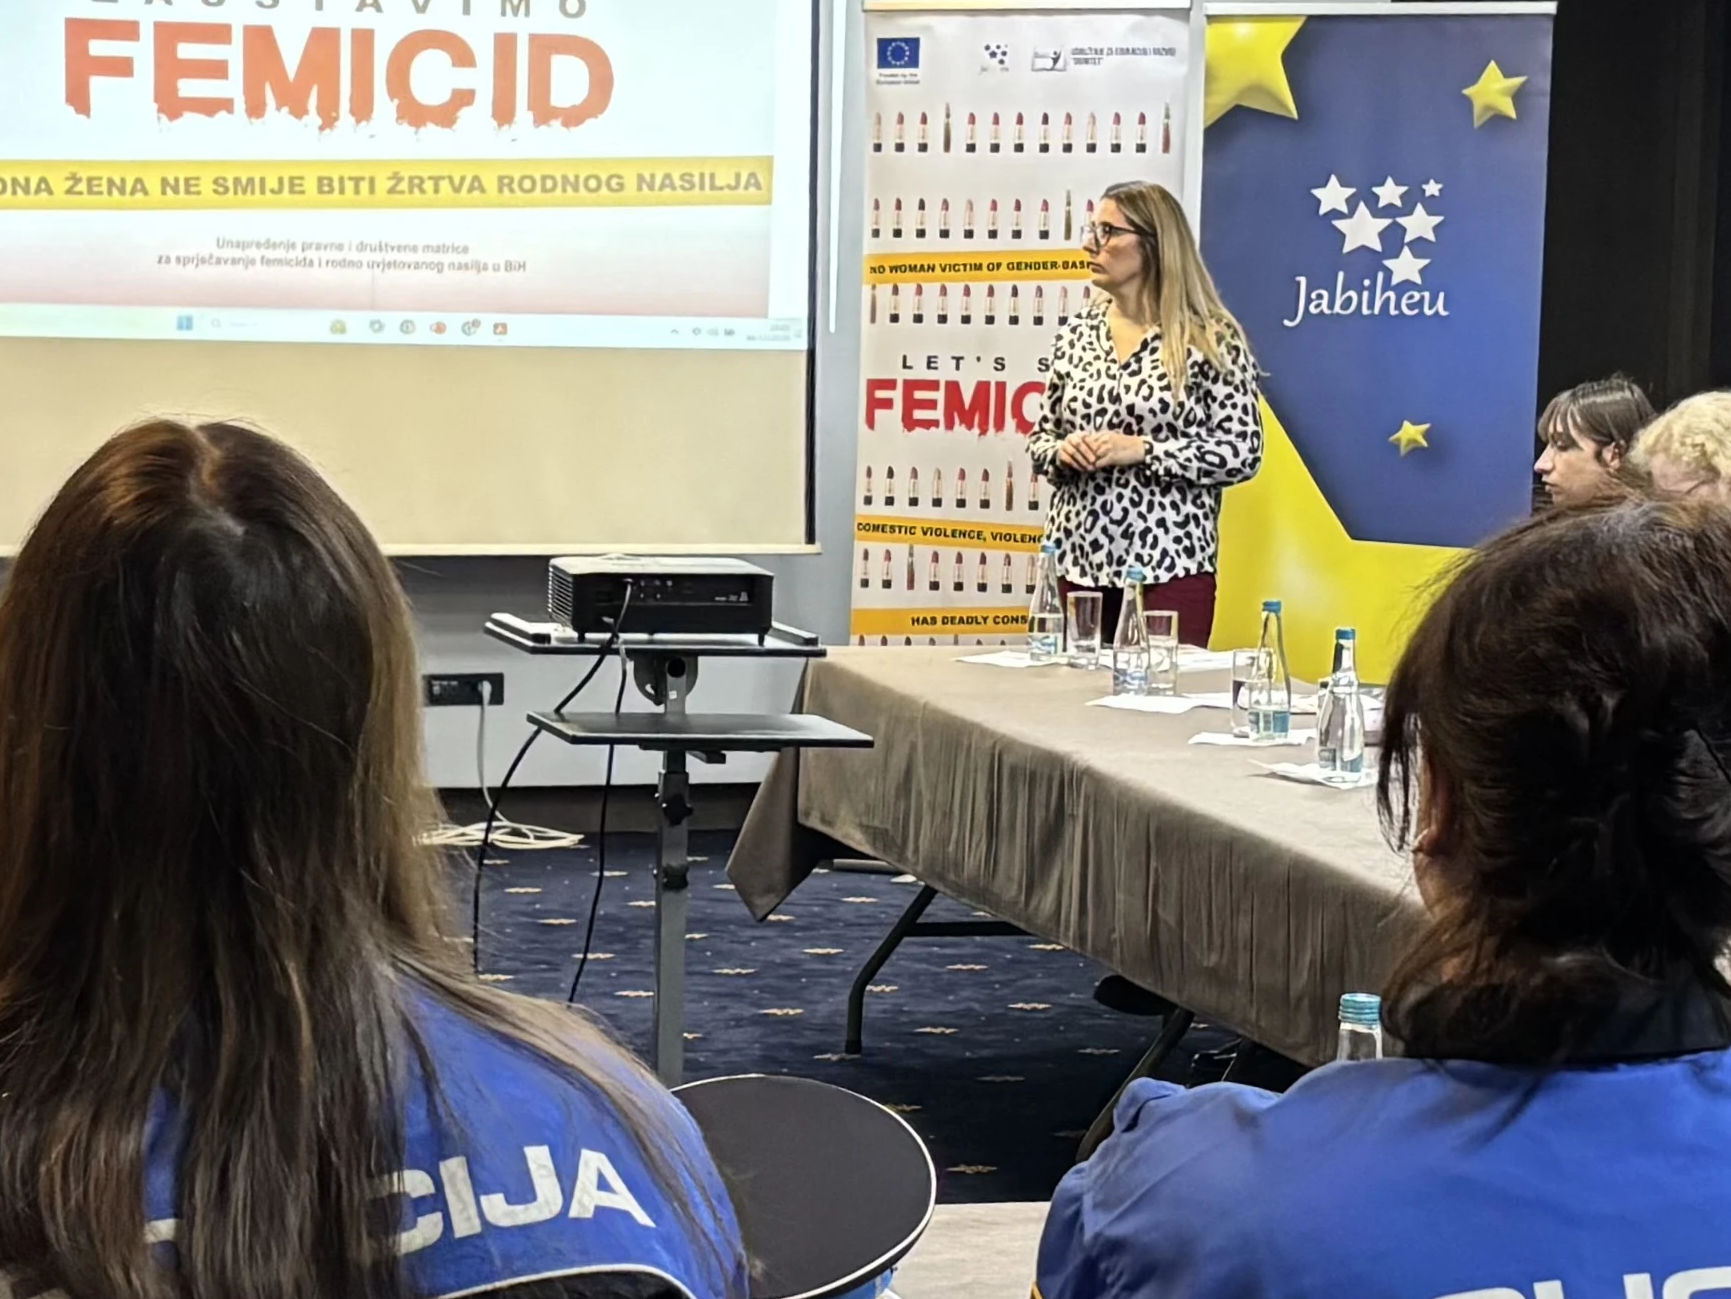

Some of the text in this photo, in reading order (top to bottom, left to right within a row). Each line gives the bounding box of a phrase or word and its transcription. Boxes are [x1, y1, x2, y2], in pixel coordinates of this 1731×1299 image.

[64, 16, 615, 133] FEMICID
[64, 171, 150, 197] ŽENA
[159, 175, 202, 197] NE
[212, 175, 306, 197] SMIJE
[316, 175, 377, 195] BITI
[386, 171, 487, 195] ŽRTVA
[496, 174, 625, 194] RODNOG
[635, 172, 764, 193] NASILJA
[888, 263, 937, 274] WOMAN
[939, 261, 984, 274] VICTIM
[987, 261, 1002, 273] OF
[1282, 270, 1450, 328] Jabiheu
[901, 354, 1007, 372] LET'S
[865, 378, 1047, 438] FEMIC
[920, 525, 987, 542] VIOLENCE,
[990, 530, 1044, 545] VIOLENC
[911, 614, 1029, 627] HAS DEADLY CONS
